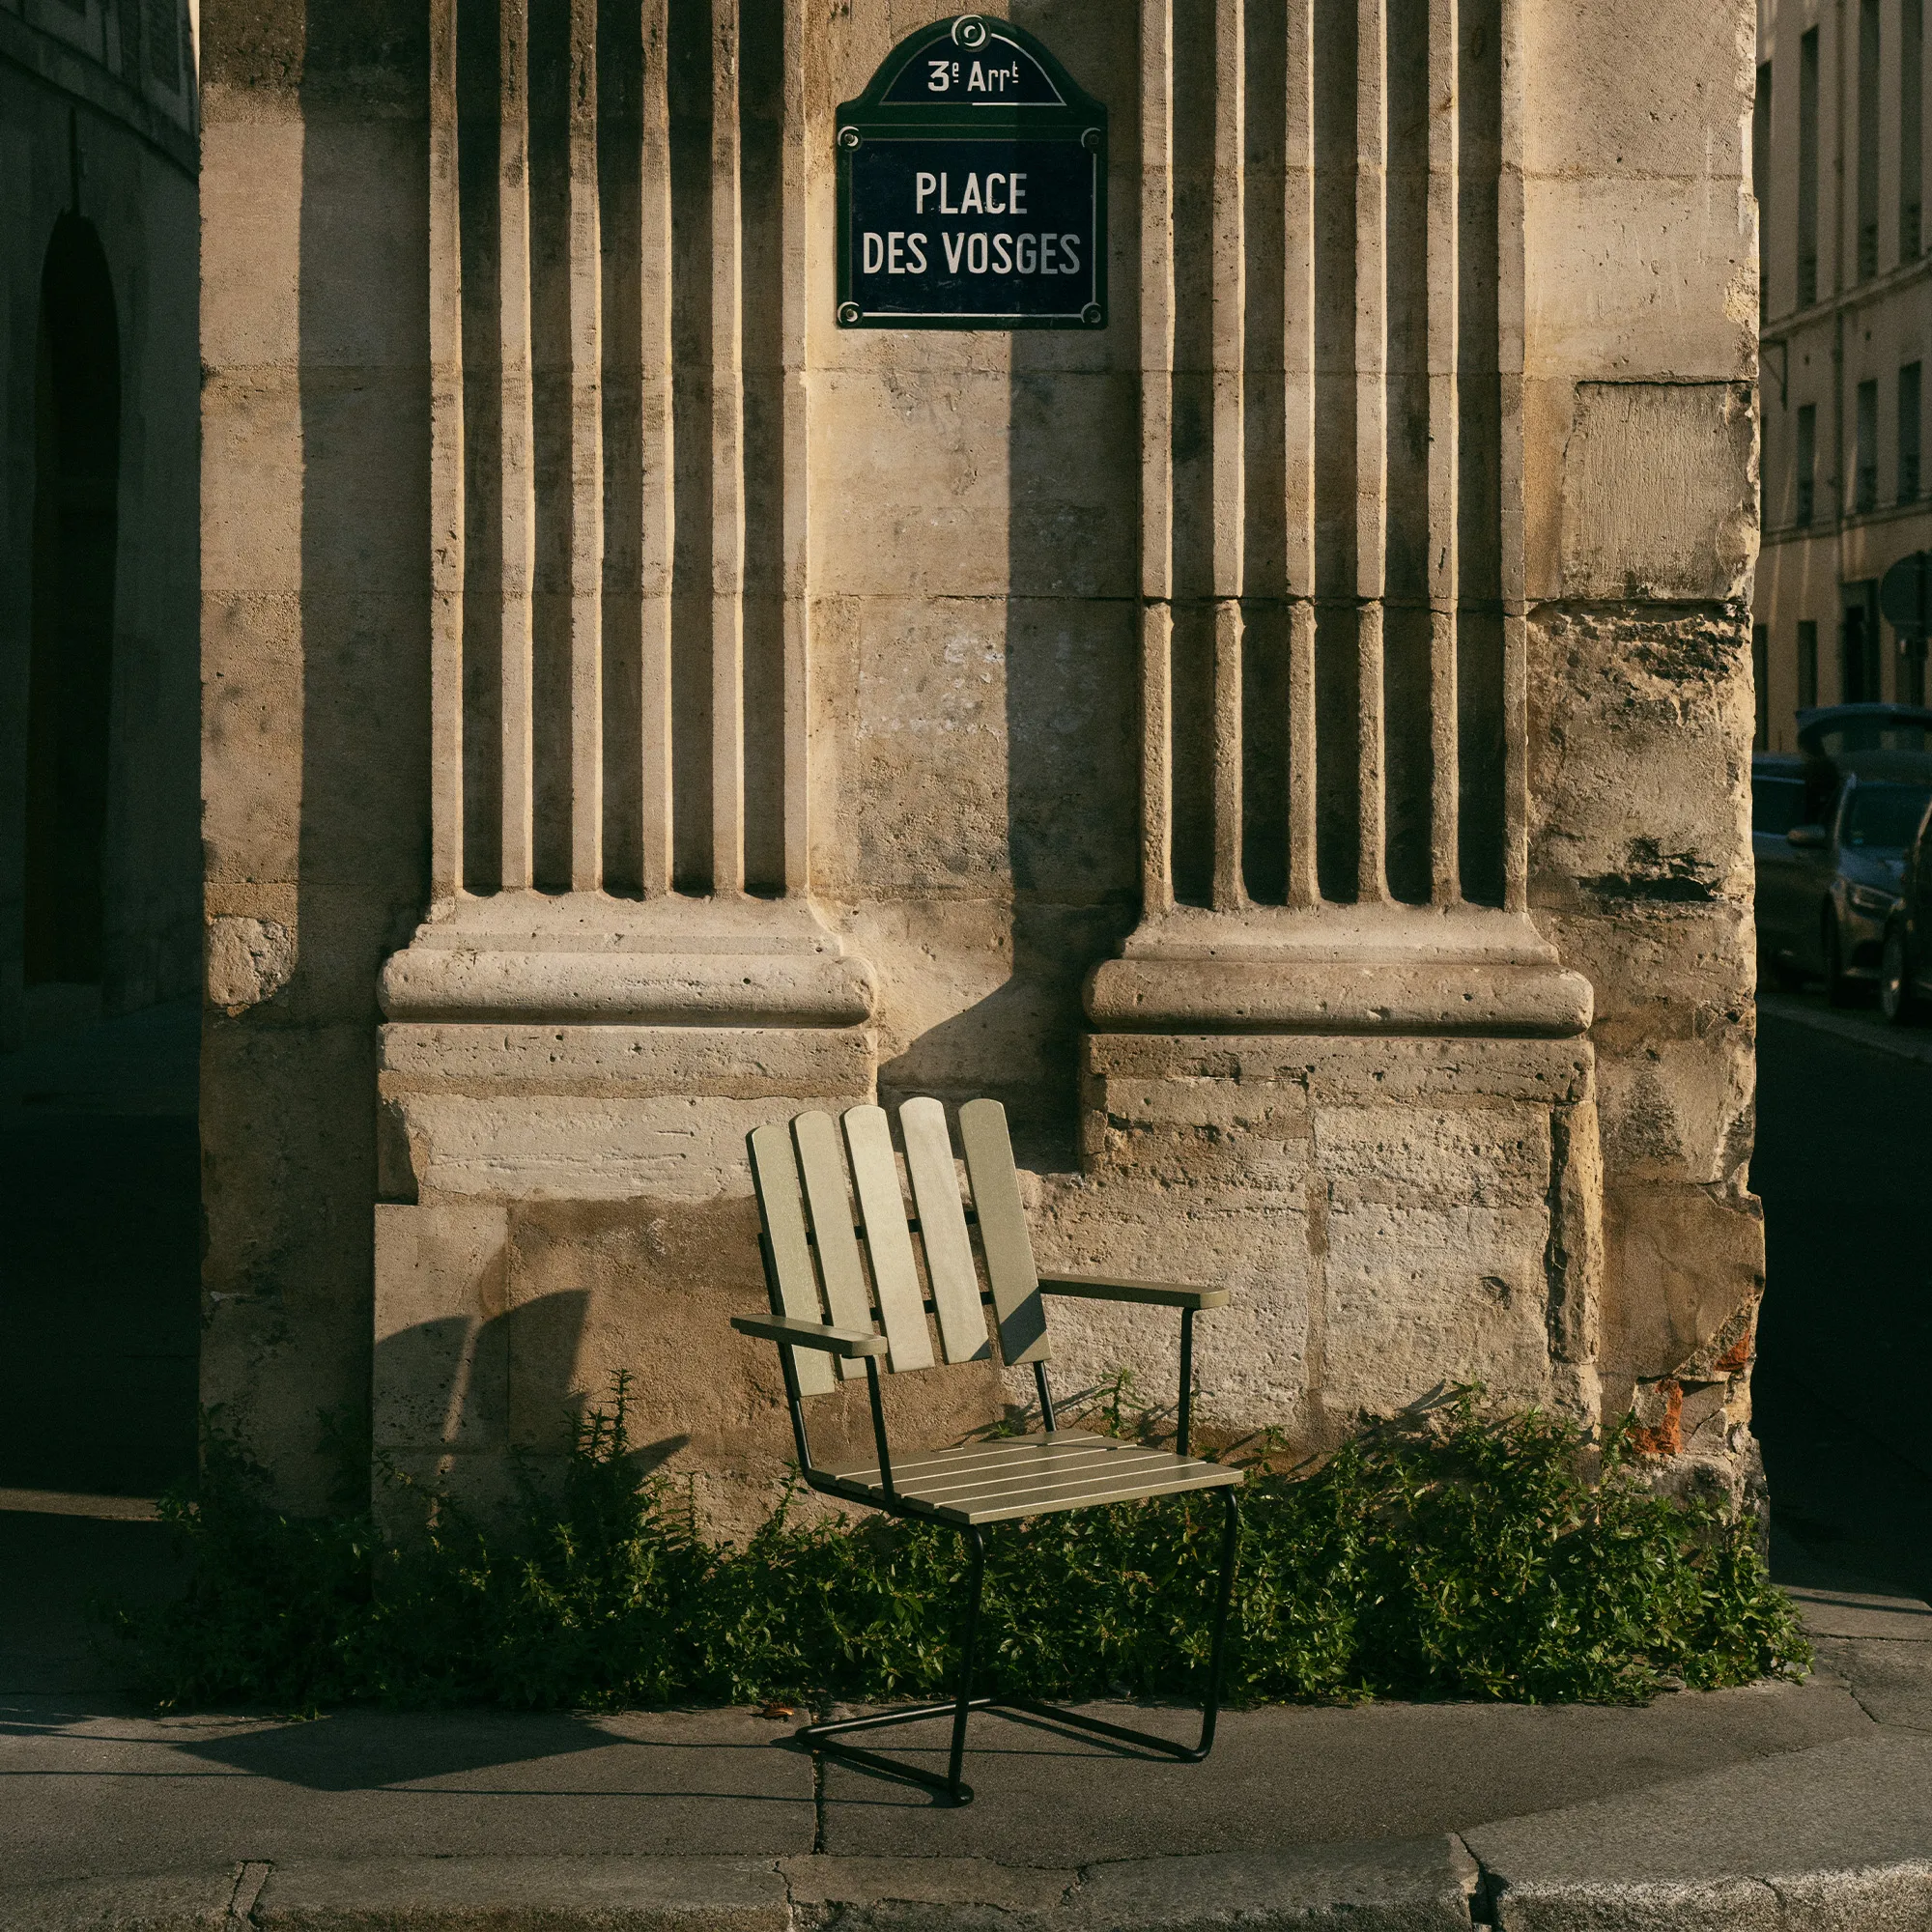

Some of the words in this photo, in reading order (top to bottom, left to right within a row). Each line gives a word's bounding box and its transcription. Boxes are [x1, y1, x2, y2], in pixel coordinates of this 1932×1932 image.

[916, 172, 1028, 214] PLACE
[863, 231, 927, 274] DES
[942, 232, 1081, 274] VOSGES
